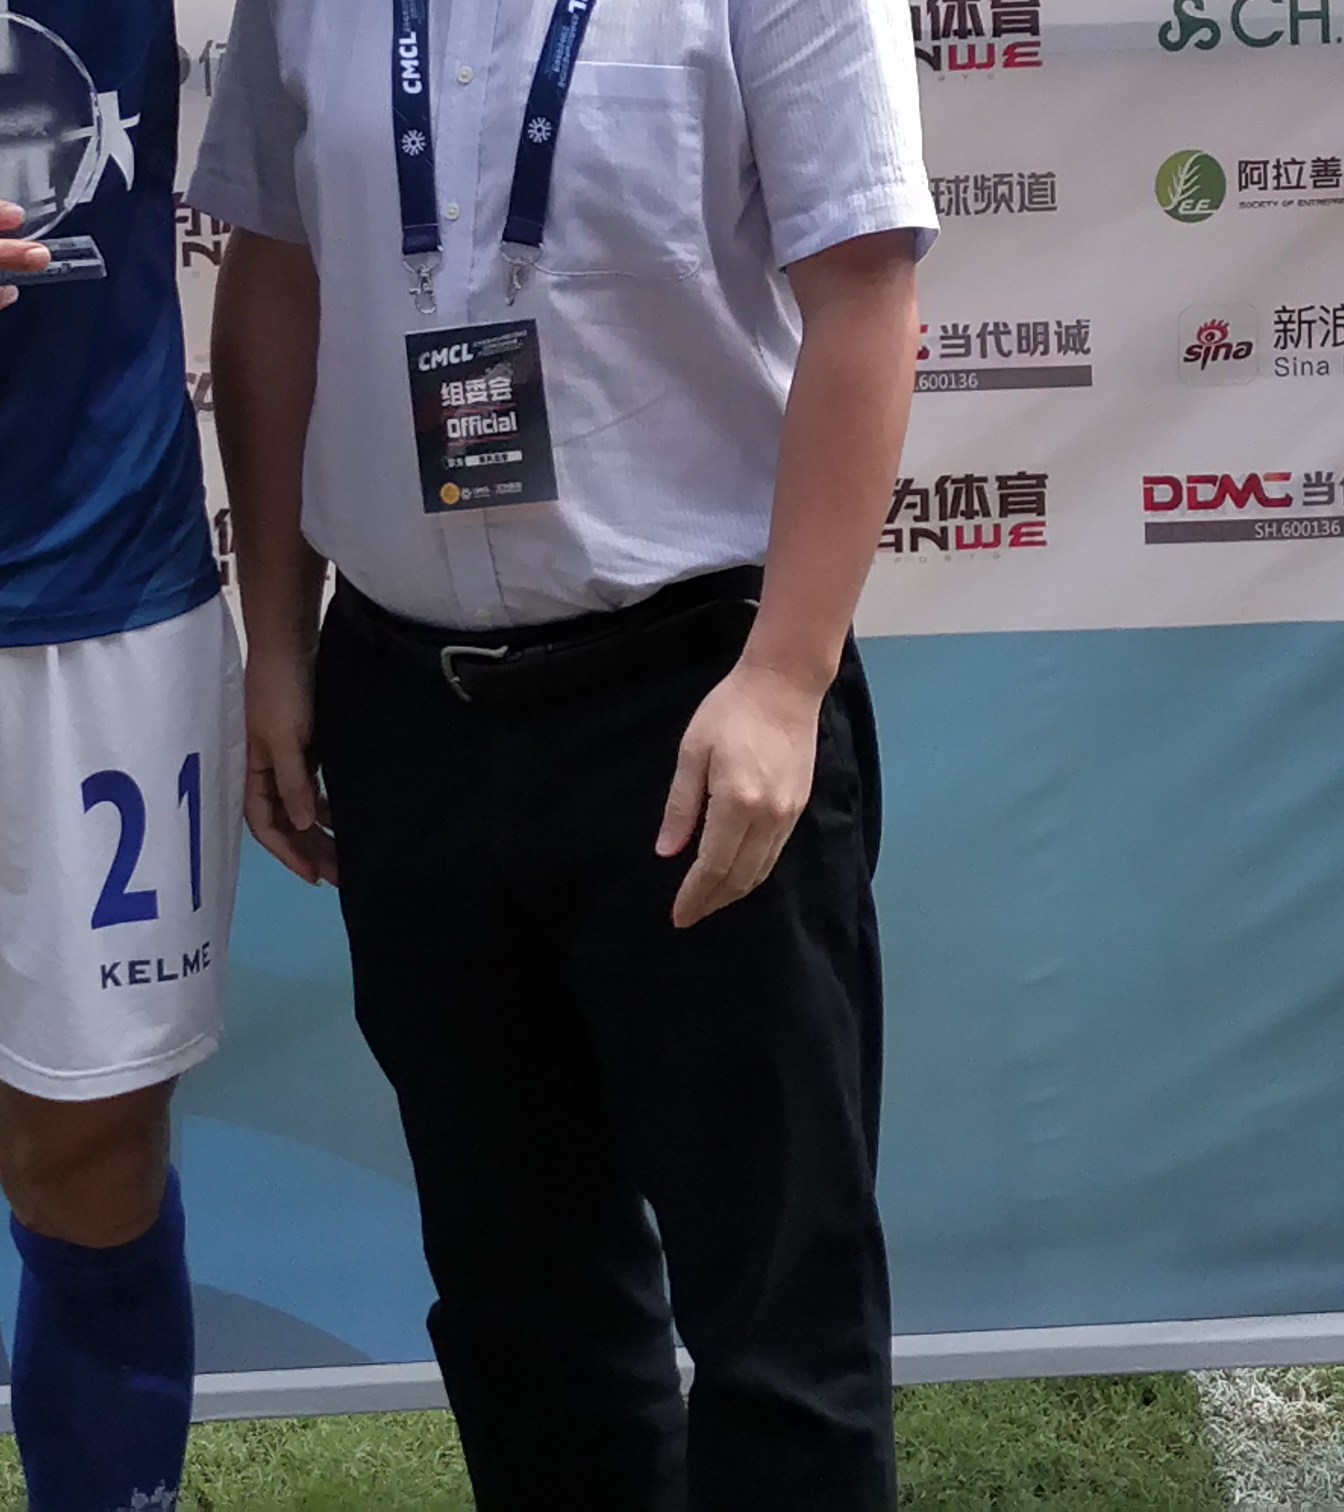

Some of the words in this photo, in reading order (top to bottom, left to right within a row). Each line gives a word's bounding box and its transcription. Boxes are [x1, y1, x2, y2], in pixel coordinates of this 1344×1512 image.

[399, 31, 423, 94] CMCL
[928, 171, 1058, 216] 球频道
[418, 342, 474, 372] CMCL
[939, 319, 1092, 360] 当代明诚
[1182, 328, 1254, 370] sina
[916, 372, 979, 390] .600136
[1274, 355, 1331, 377] Sina
[440, 376, 514, 407] 组委会
[446, 411, 518, 439] Official
[885, 471, 1049, 524] 为体育
[1142, 471, 1293, 513] DDMC
[877, 520, 1048, 553] ANWE
[1254, 519, 1342, 539] SH.600136
[80, 752, 202, 930] 21
[100, 941, 212, 989] KELME
